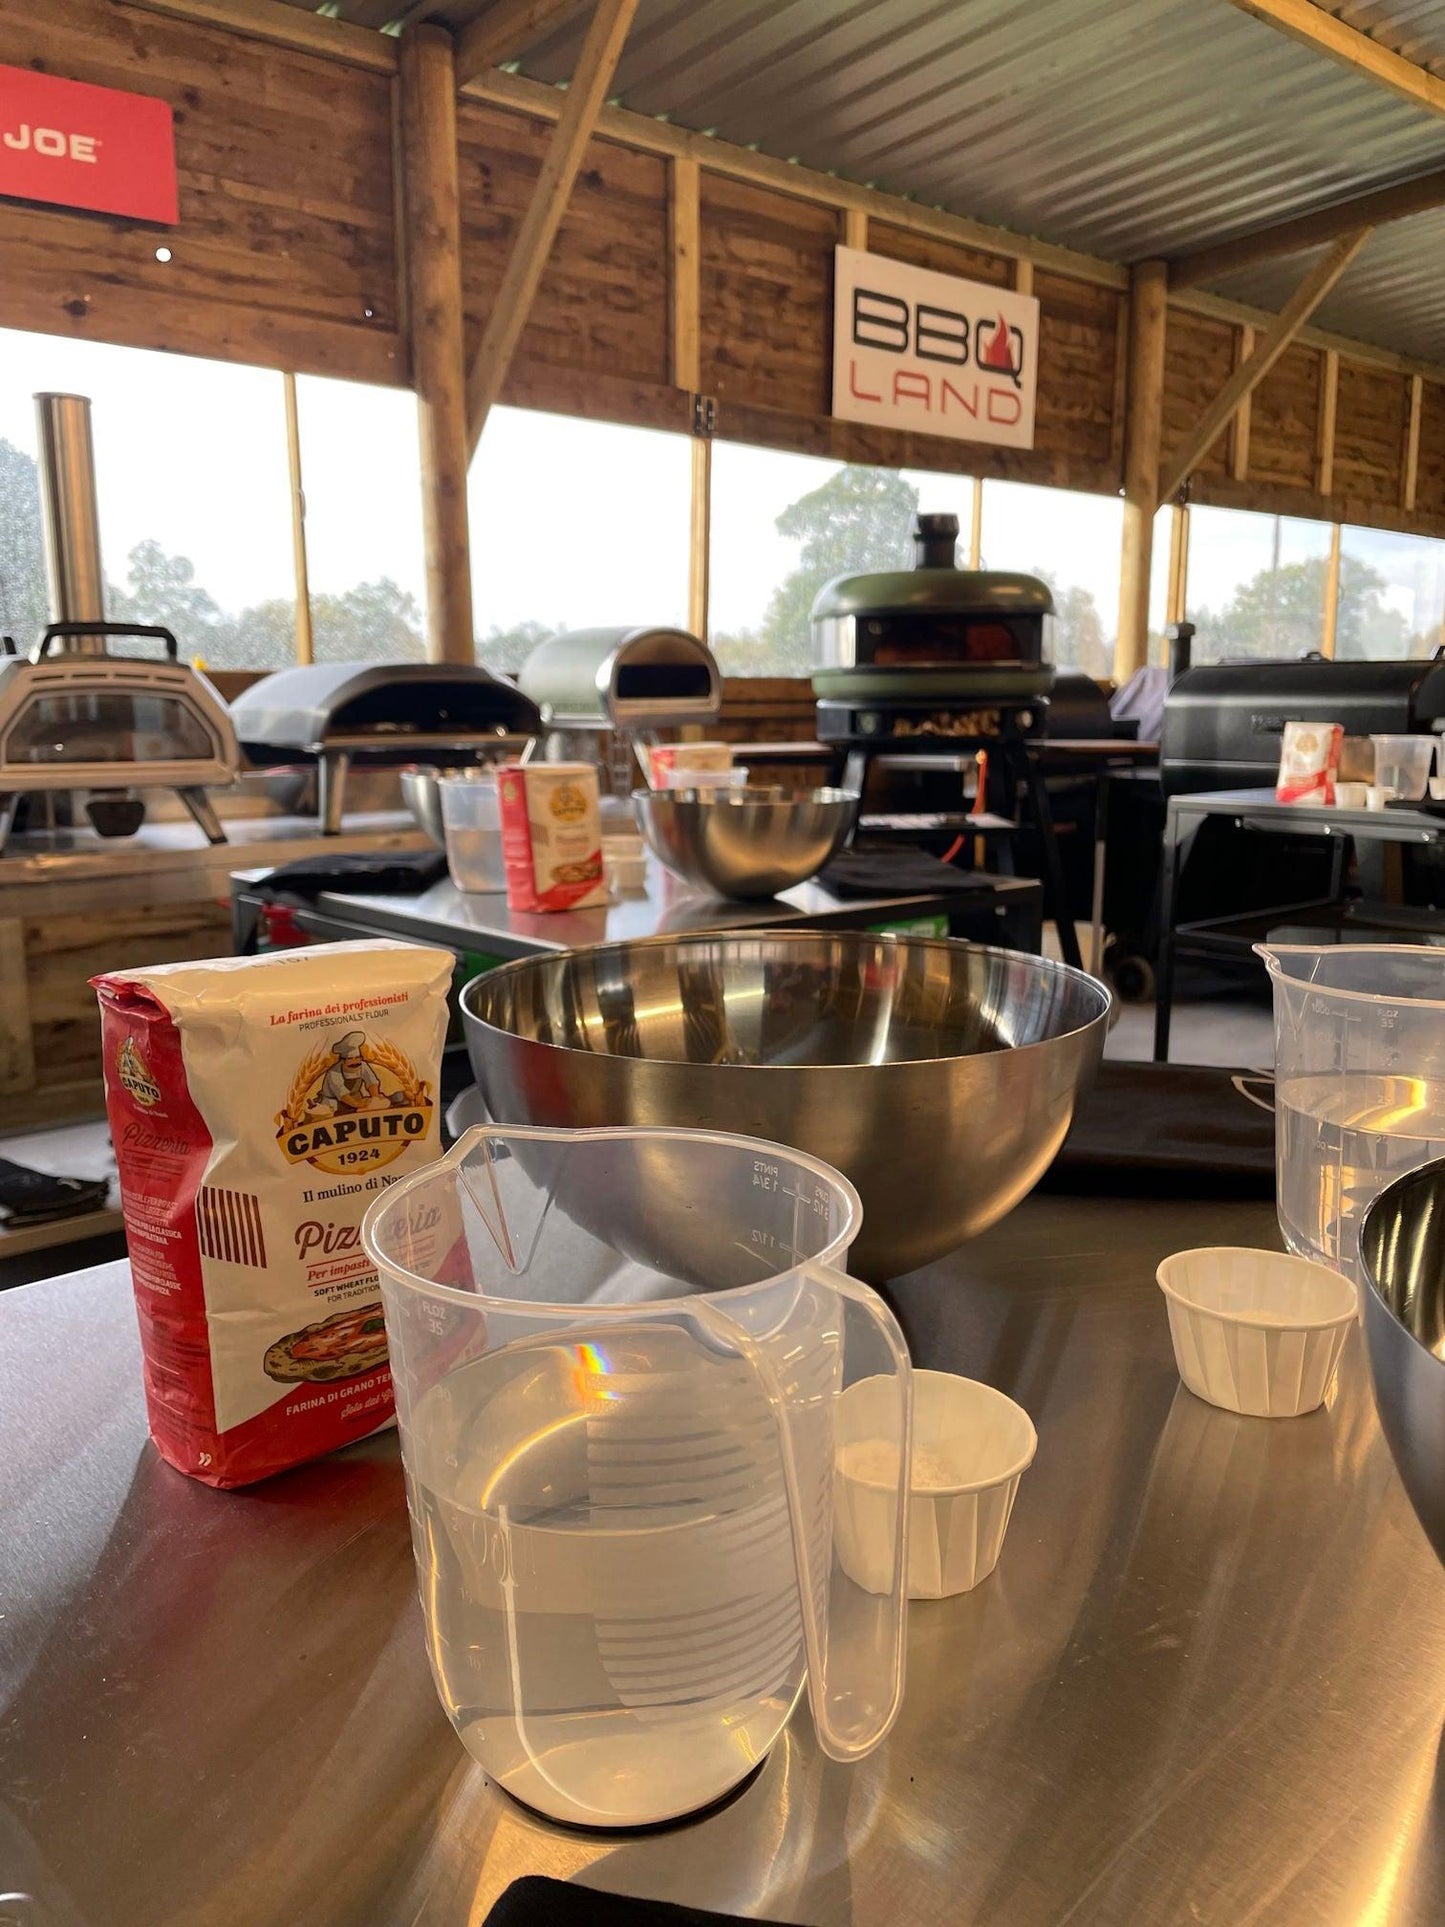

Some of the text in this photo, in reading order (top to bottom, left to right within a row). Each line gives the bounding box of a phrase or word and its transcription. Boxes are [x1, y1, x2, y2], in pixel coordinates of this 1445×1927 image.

[3, 123, 97, 164] JOE
[853, 287, 1023, 389] BBQ
[850, 359, 1021, 425] LAND
[269, 991, 409, 1026] La farina dei professionisti
[365, 1008, 390, 1020] FLOUR
[122, 1076, 160, 1099] CAPUTO
[122, 1121, 190, 1155] Pizzeria
[287, 1112, 424, 1156] CAPUTO
[338, 1148, 380, 1165] 1924
[318, 1182, 362, 1200] mulino
[365, 1177, 379, 1190] di
[307, 1259, 370, 1281] Per impasti
[314, 1285, 334, 1297] SOFT
[336, 1279, 364, 1292] WHEAT
[327, 1293, 342, 1303] FOR
[428, 1318, 444, 1337] 35
[286, 1396, 326, 1416] FARINA
[327, 1392, 339, 1403] DI
[339, 1379, 374, 1398] GRANO
